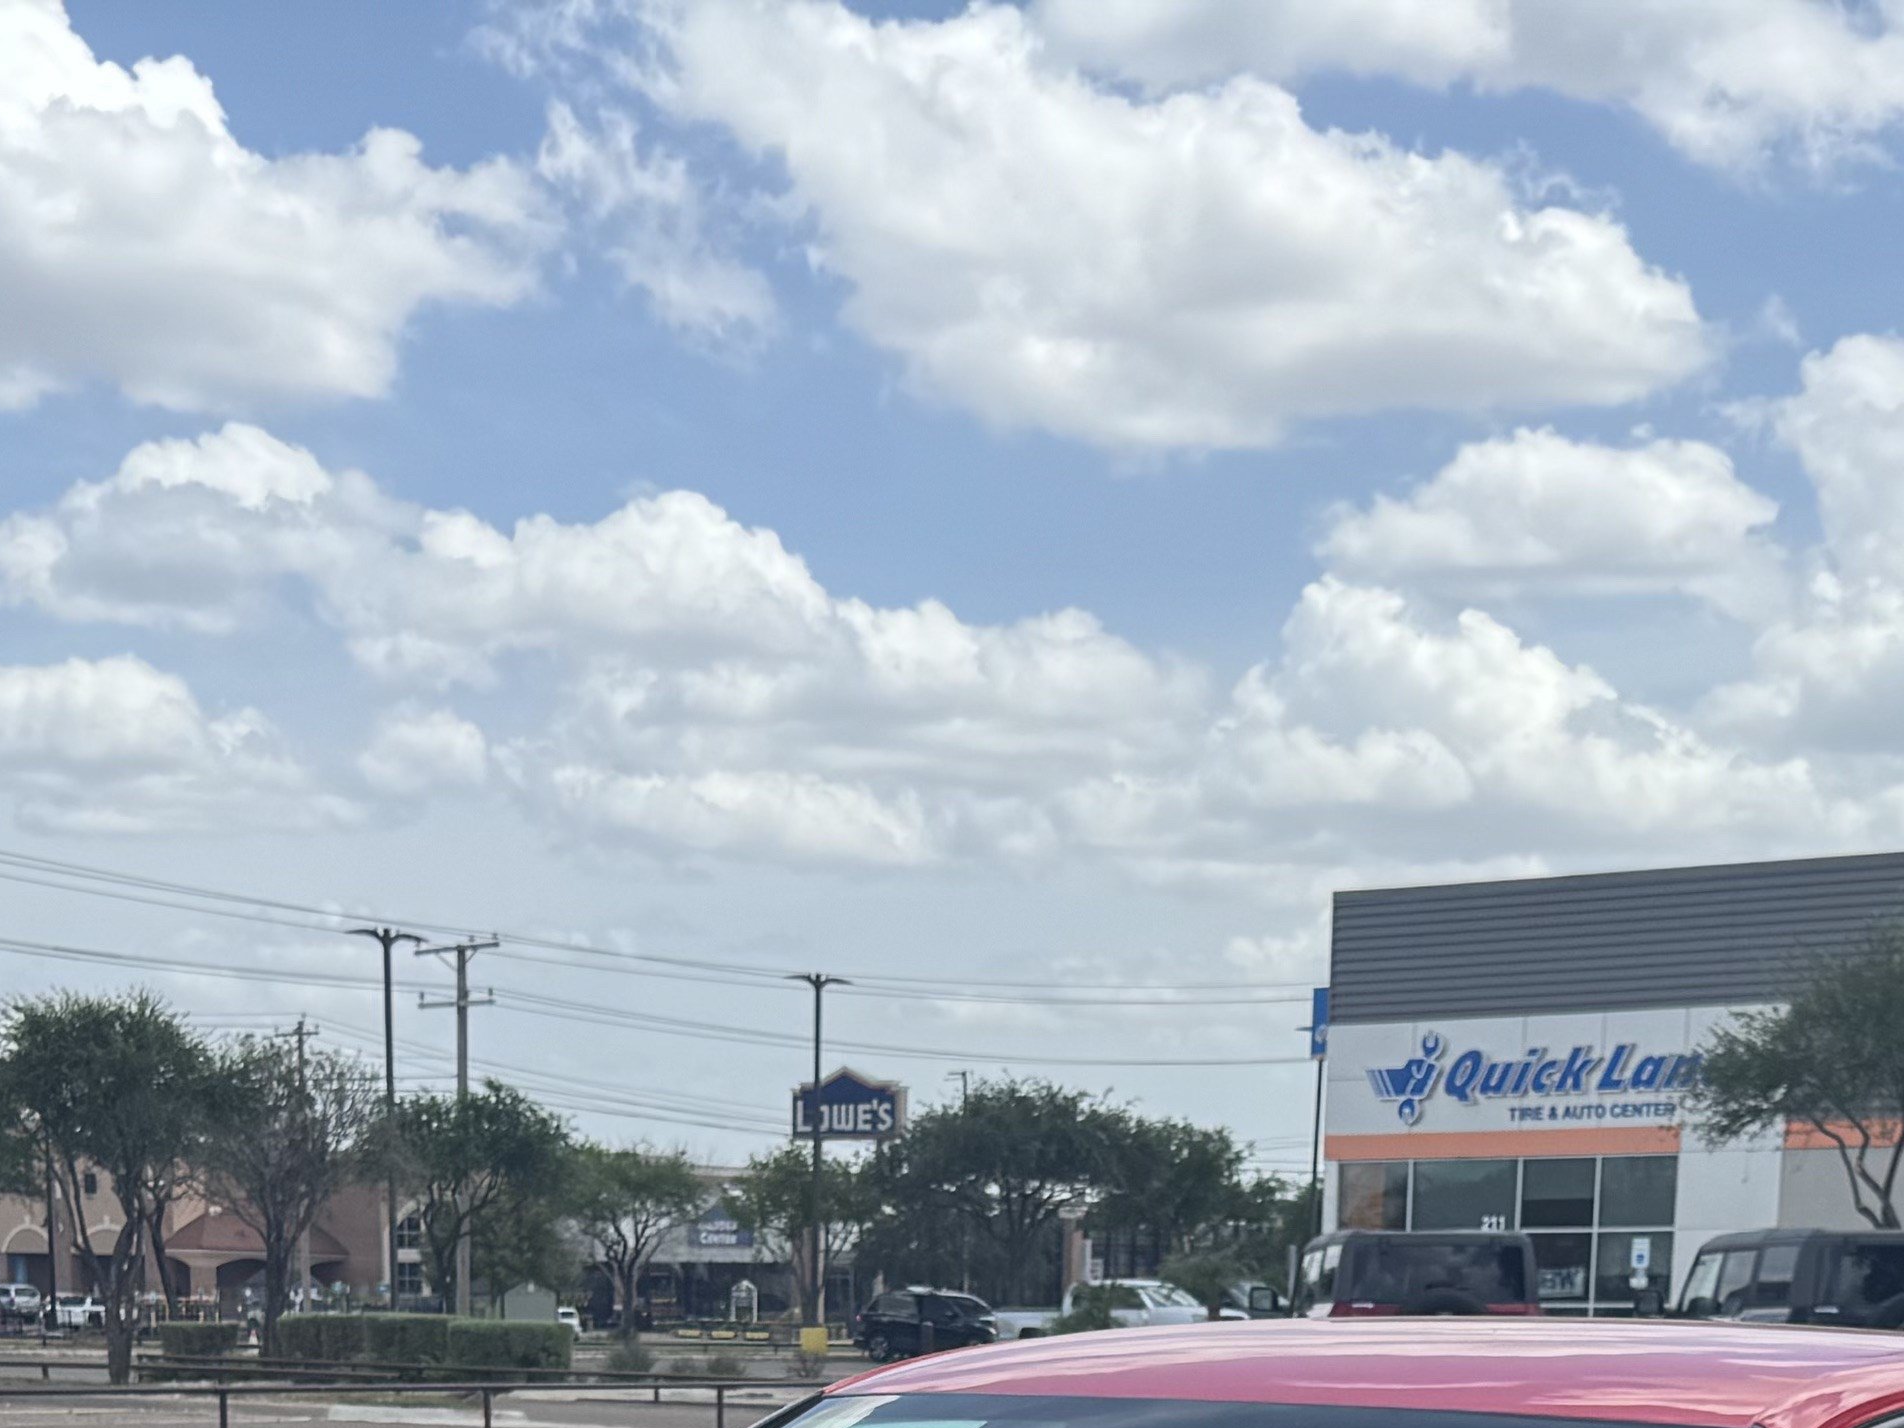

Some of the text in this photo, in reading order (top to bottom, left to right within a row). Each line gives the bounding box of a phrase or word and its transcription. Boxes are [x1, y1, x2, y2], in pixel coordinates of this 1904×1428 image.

[1445, 1044, 1703, 1104] Quick Lan
[1508, 1103, 1677, 1121] TIRE & AUTO CENTER
